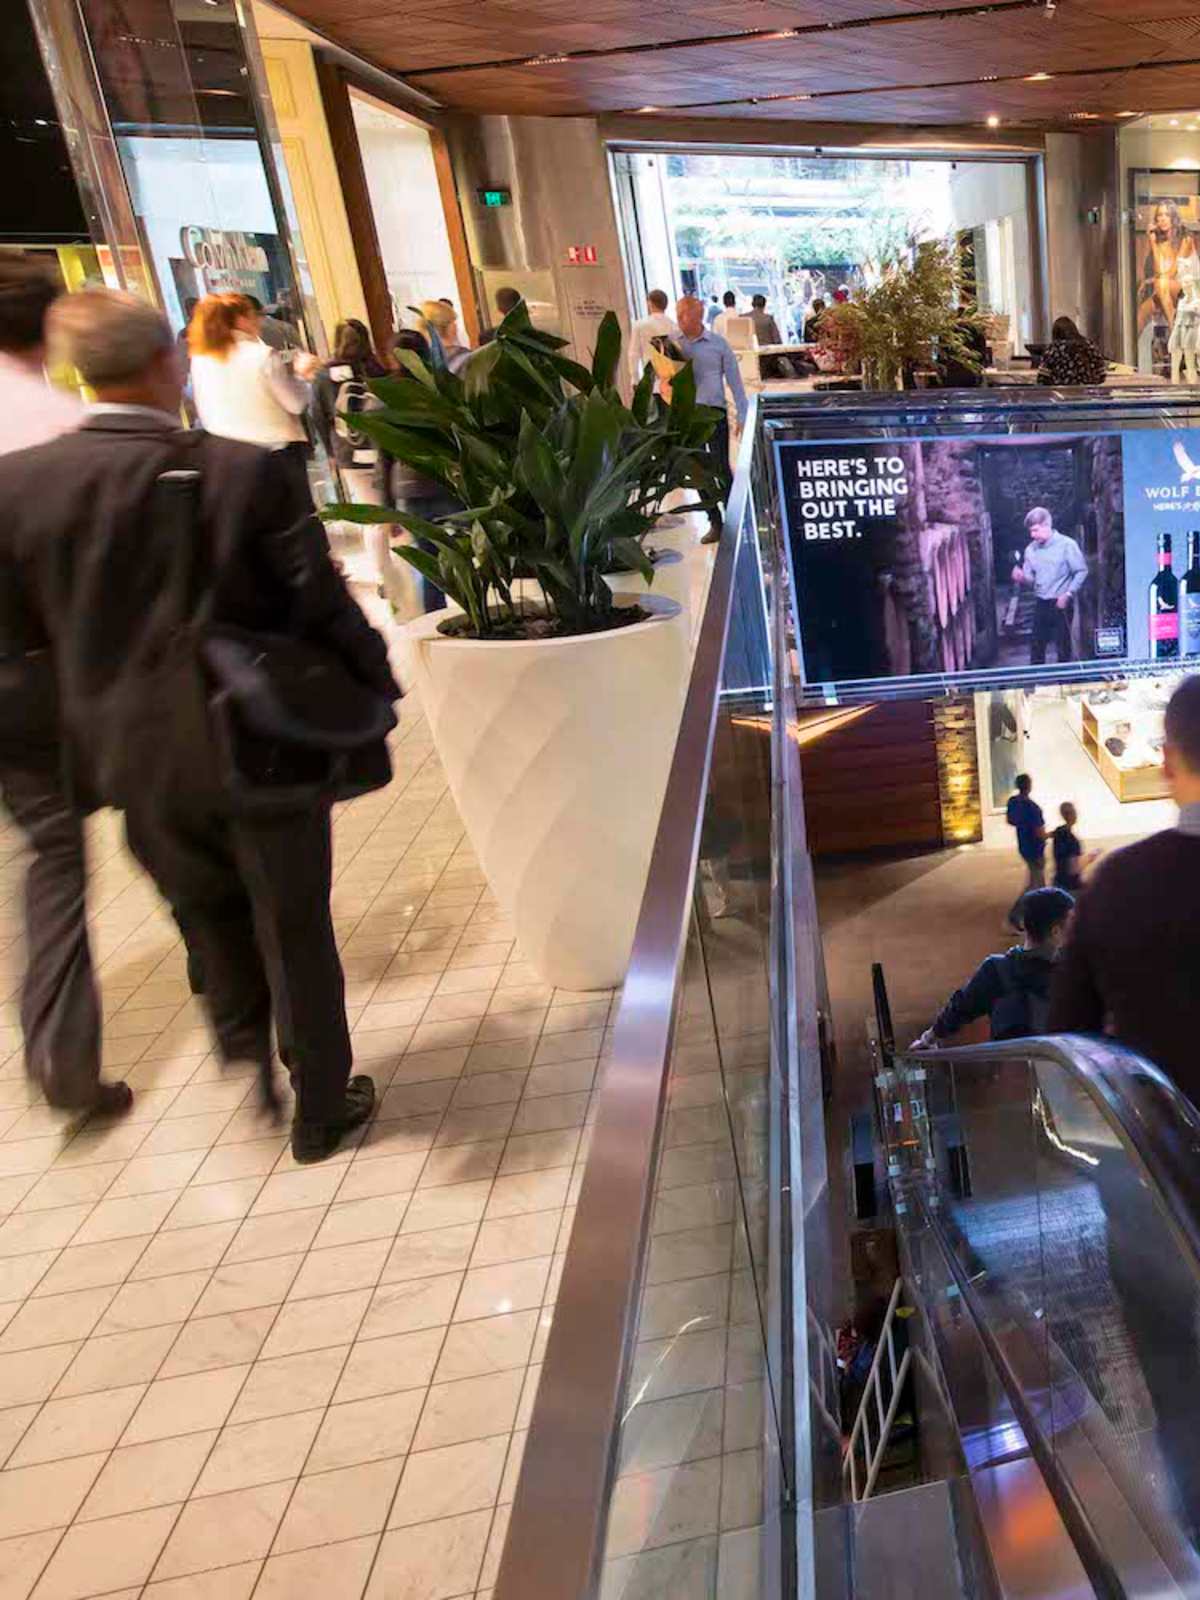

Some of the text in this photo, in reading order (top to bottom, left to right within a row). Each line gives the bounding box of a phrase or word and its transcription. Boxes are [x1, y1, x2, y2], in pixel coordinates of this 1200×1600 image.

[797, 456, 905, 477] HERE'S TO
[800, 478, 909, 498] BRINGING
[1144, 485, 1190, 499] WOLF
[801, 499, 897, 519] OUT THE
[803, 520, 863, 540] BEST.
